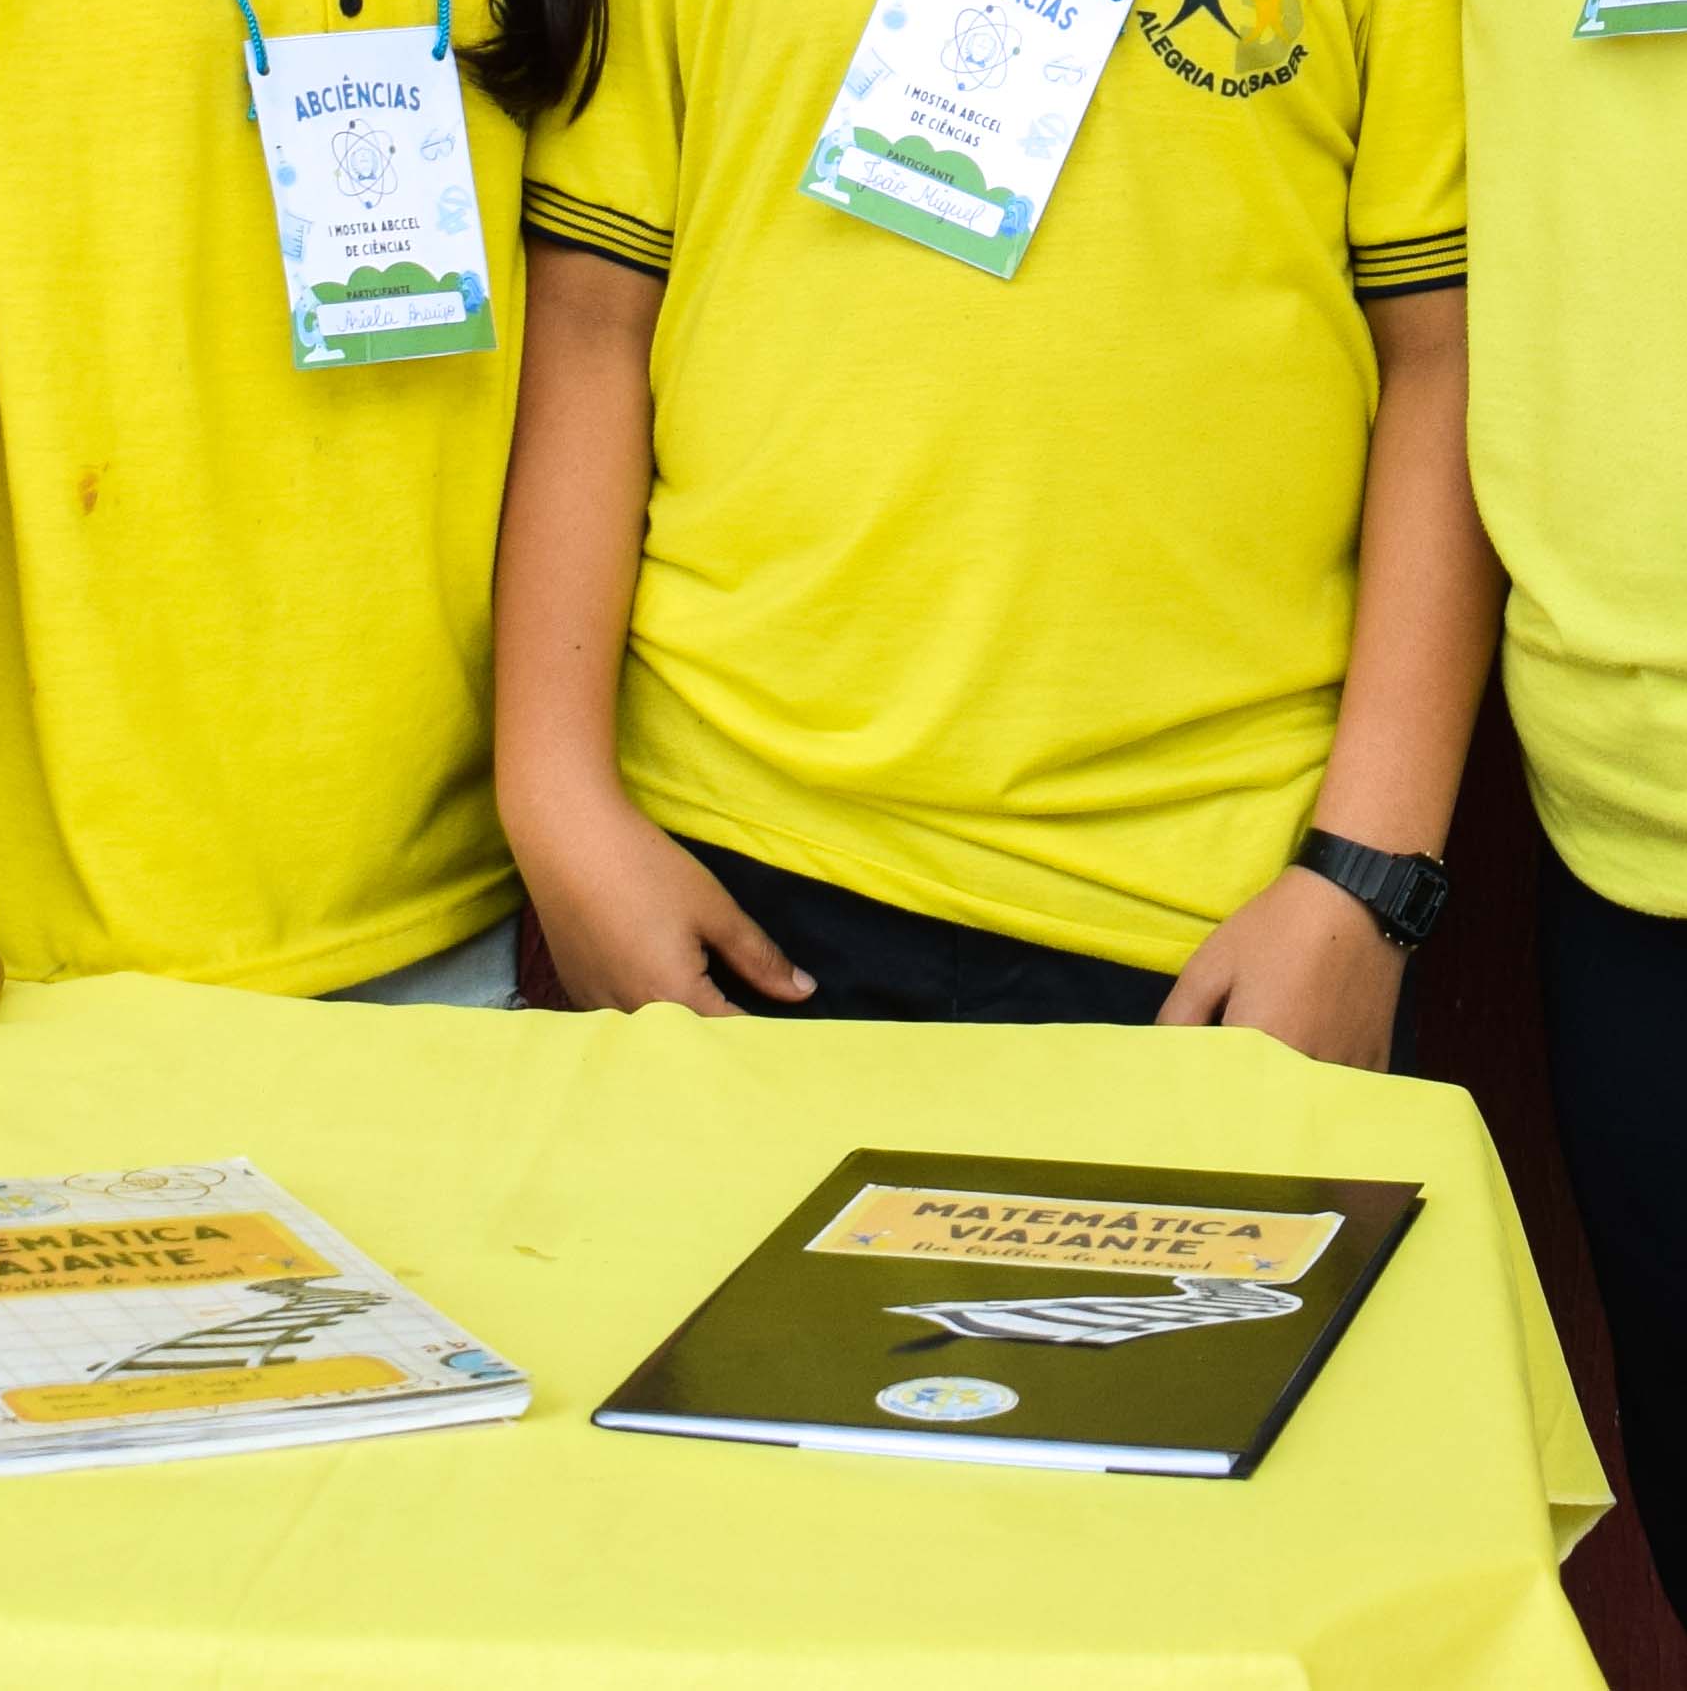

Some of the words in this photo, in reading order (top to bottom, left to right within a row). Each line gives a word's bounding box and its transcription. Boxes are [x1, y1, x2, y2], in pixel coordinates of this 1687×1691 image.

[1136, 10, 1215, 92] ALEGRIA
[1248, 44, 1310, 94] SABER
[295, 74, 420, 121] ABCIÊNCIAS
[911, 87, 957, 115] MOSTRA
[959, 108, 1002, 134] ABCCEL
[910, 110, 926, 126] DE
[928, 118, 981, 148] CIÊNCIAS
[886, 149, 955, 185] PARTICIPANTE
[335, 221, 377, 237] MOSTRA
[345, 244, 359, 257] DE
[912, 1201, 1264, 1240] MATEMÁTICA
[948, 1223, 1206, 1256] VIAJANTE
